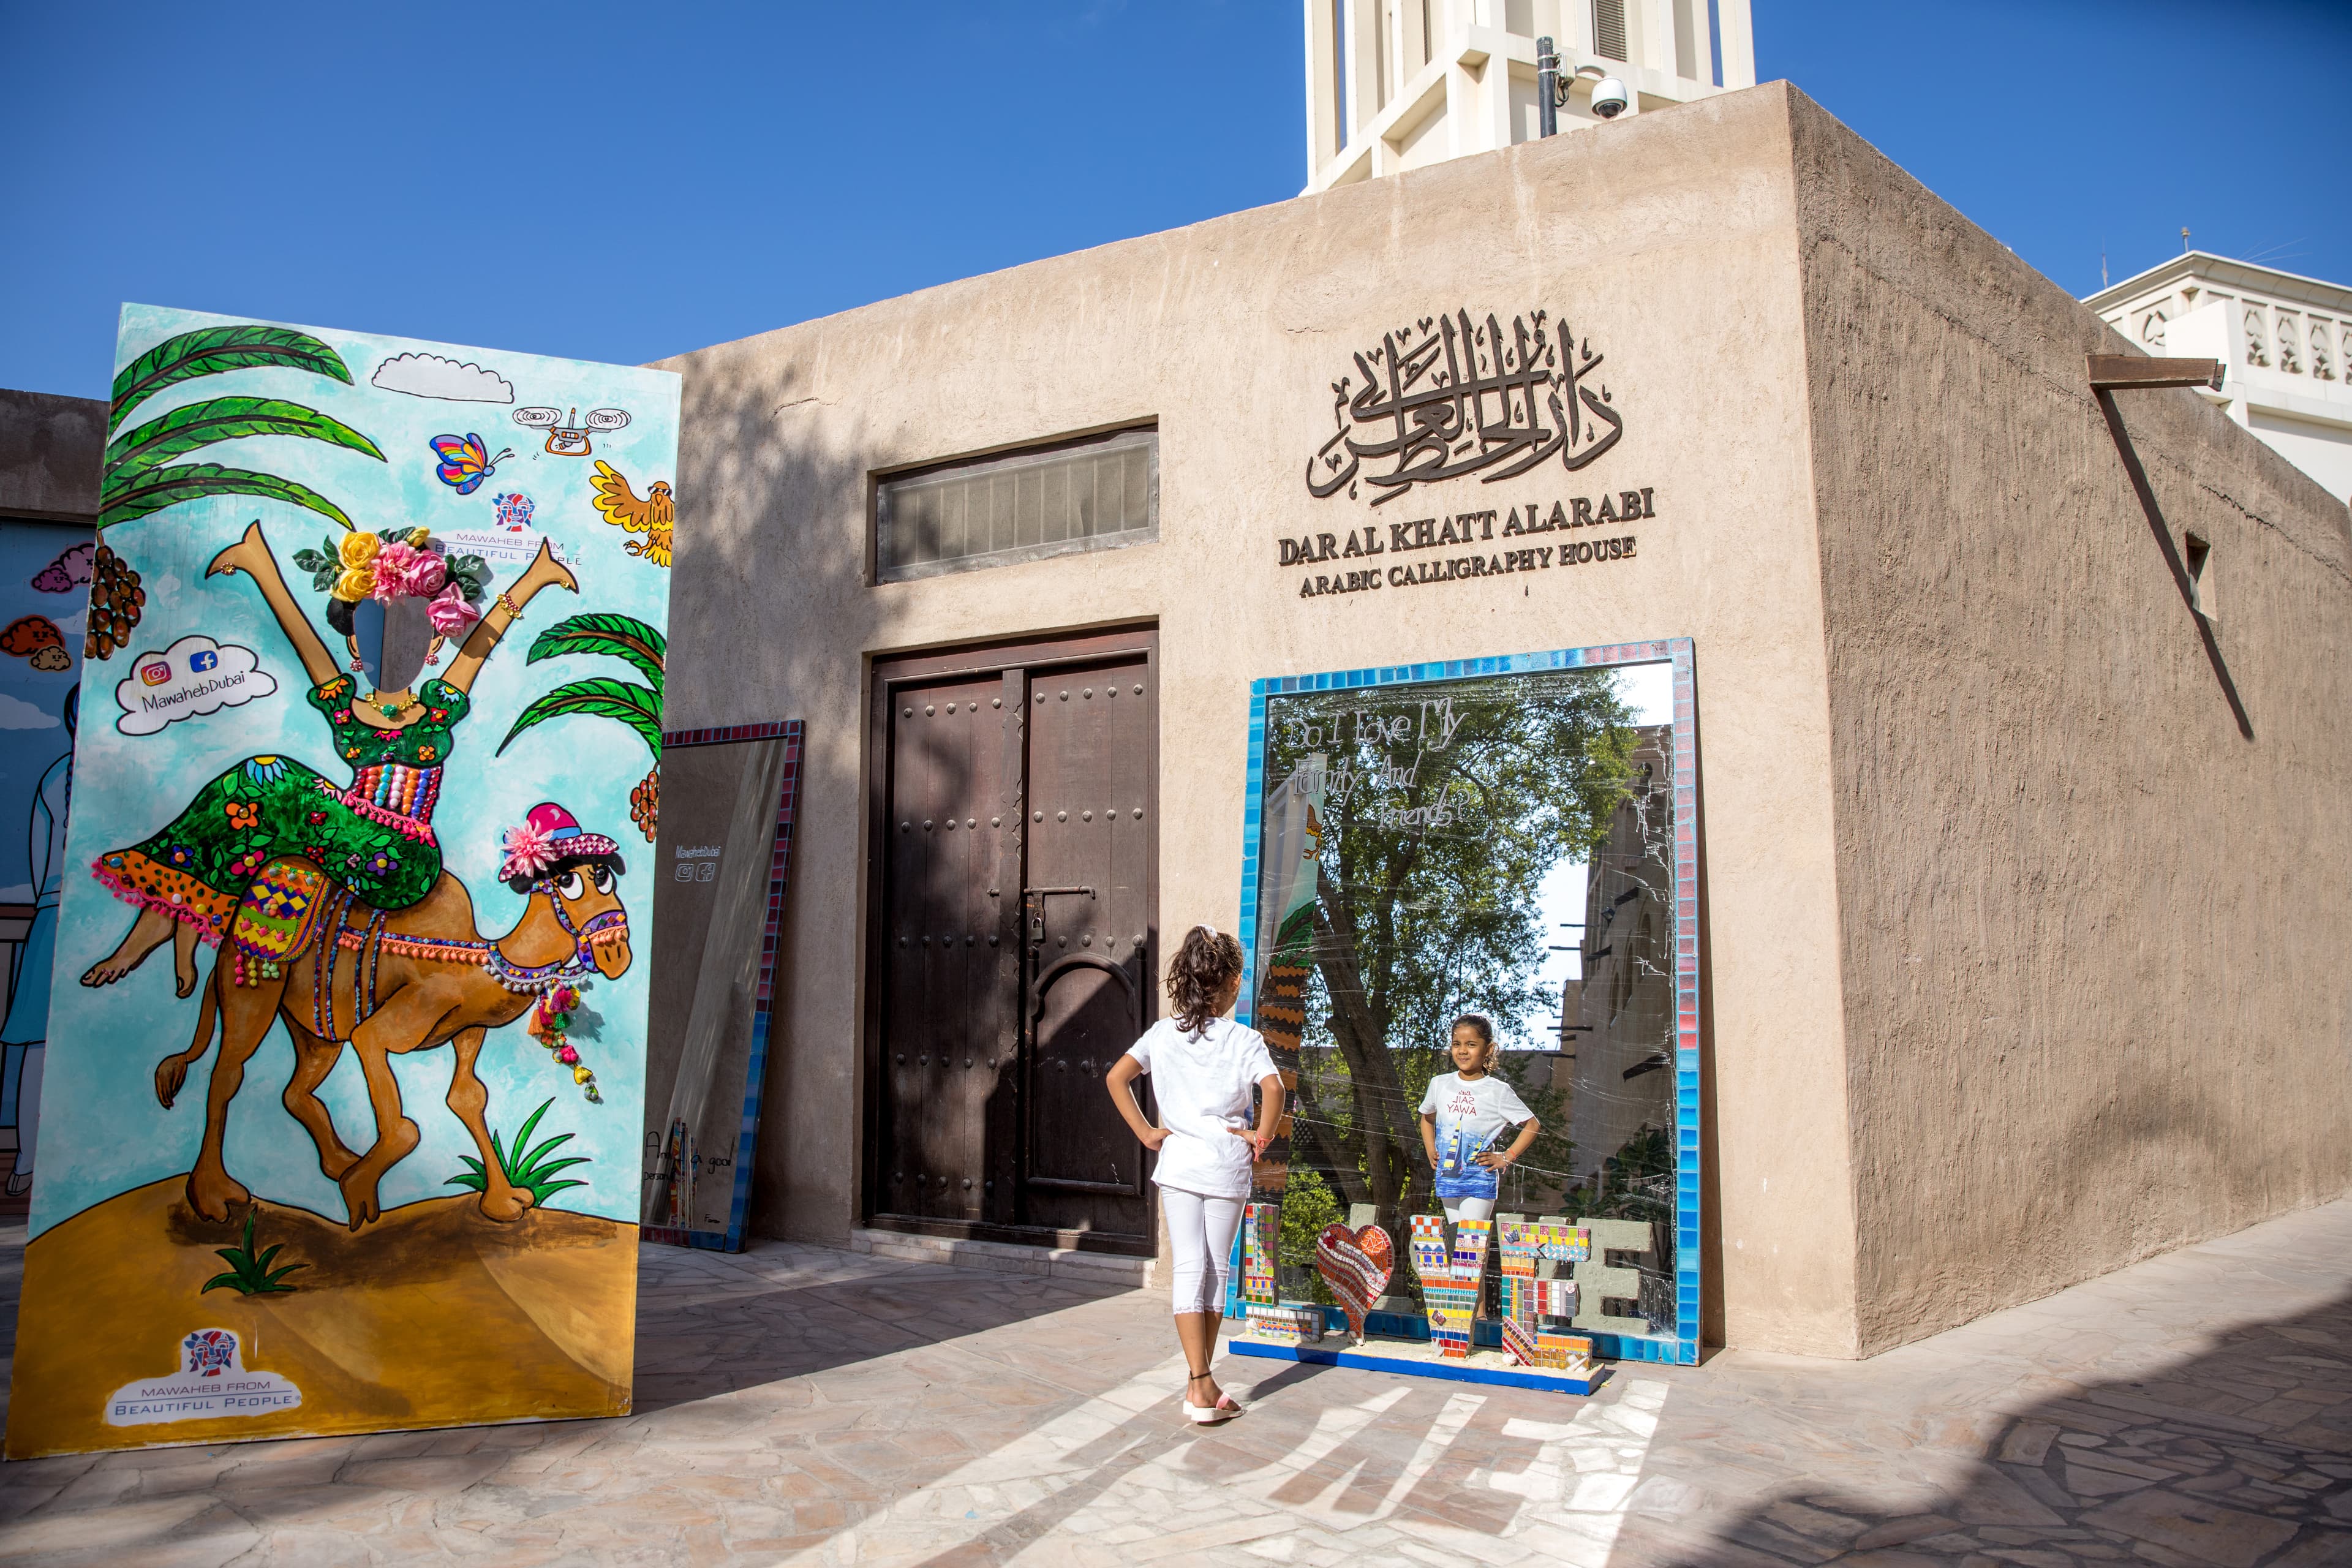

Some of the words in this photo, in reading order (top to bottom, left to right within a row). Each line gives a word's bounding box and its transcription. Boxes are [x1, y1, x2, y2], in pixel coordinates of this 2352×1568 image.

[435, 545, 517, 560] BEAUTIFUL
[526, 553, 582, 565] PPLE
[457, 533, 522, 546] MAWAHEB
[1278, 532, 1338, 566] DAR
[1342, 527, 1384, 558] AL
[1389, 510, 1496, 552] KHATT
[1300, 568, 1382, 598] ARABIC
[1388, 547, 1553, 587] CALLIGRAPHY
[1558, 537, 1637, 566] HOUSE
[1284, 720, 1322, 748] Do
[1327, 713, 1346, 744] I
[1418, 697, 1471, 751] My
[1294, 757, 1368, 806] Family
[1372, 750, 1423, 789] And
[707, 1137, 735, 1174] good
[141, 1384, 221, 1397] MAWAHEB
[227, 1381, 270, 1391] FROM
[115, 1401, 214, 1415] BEAUTIFUL
